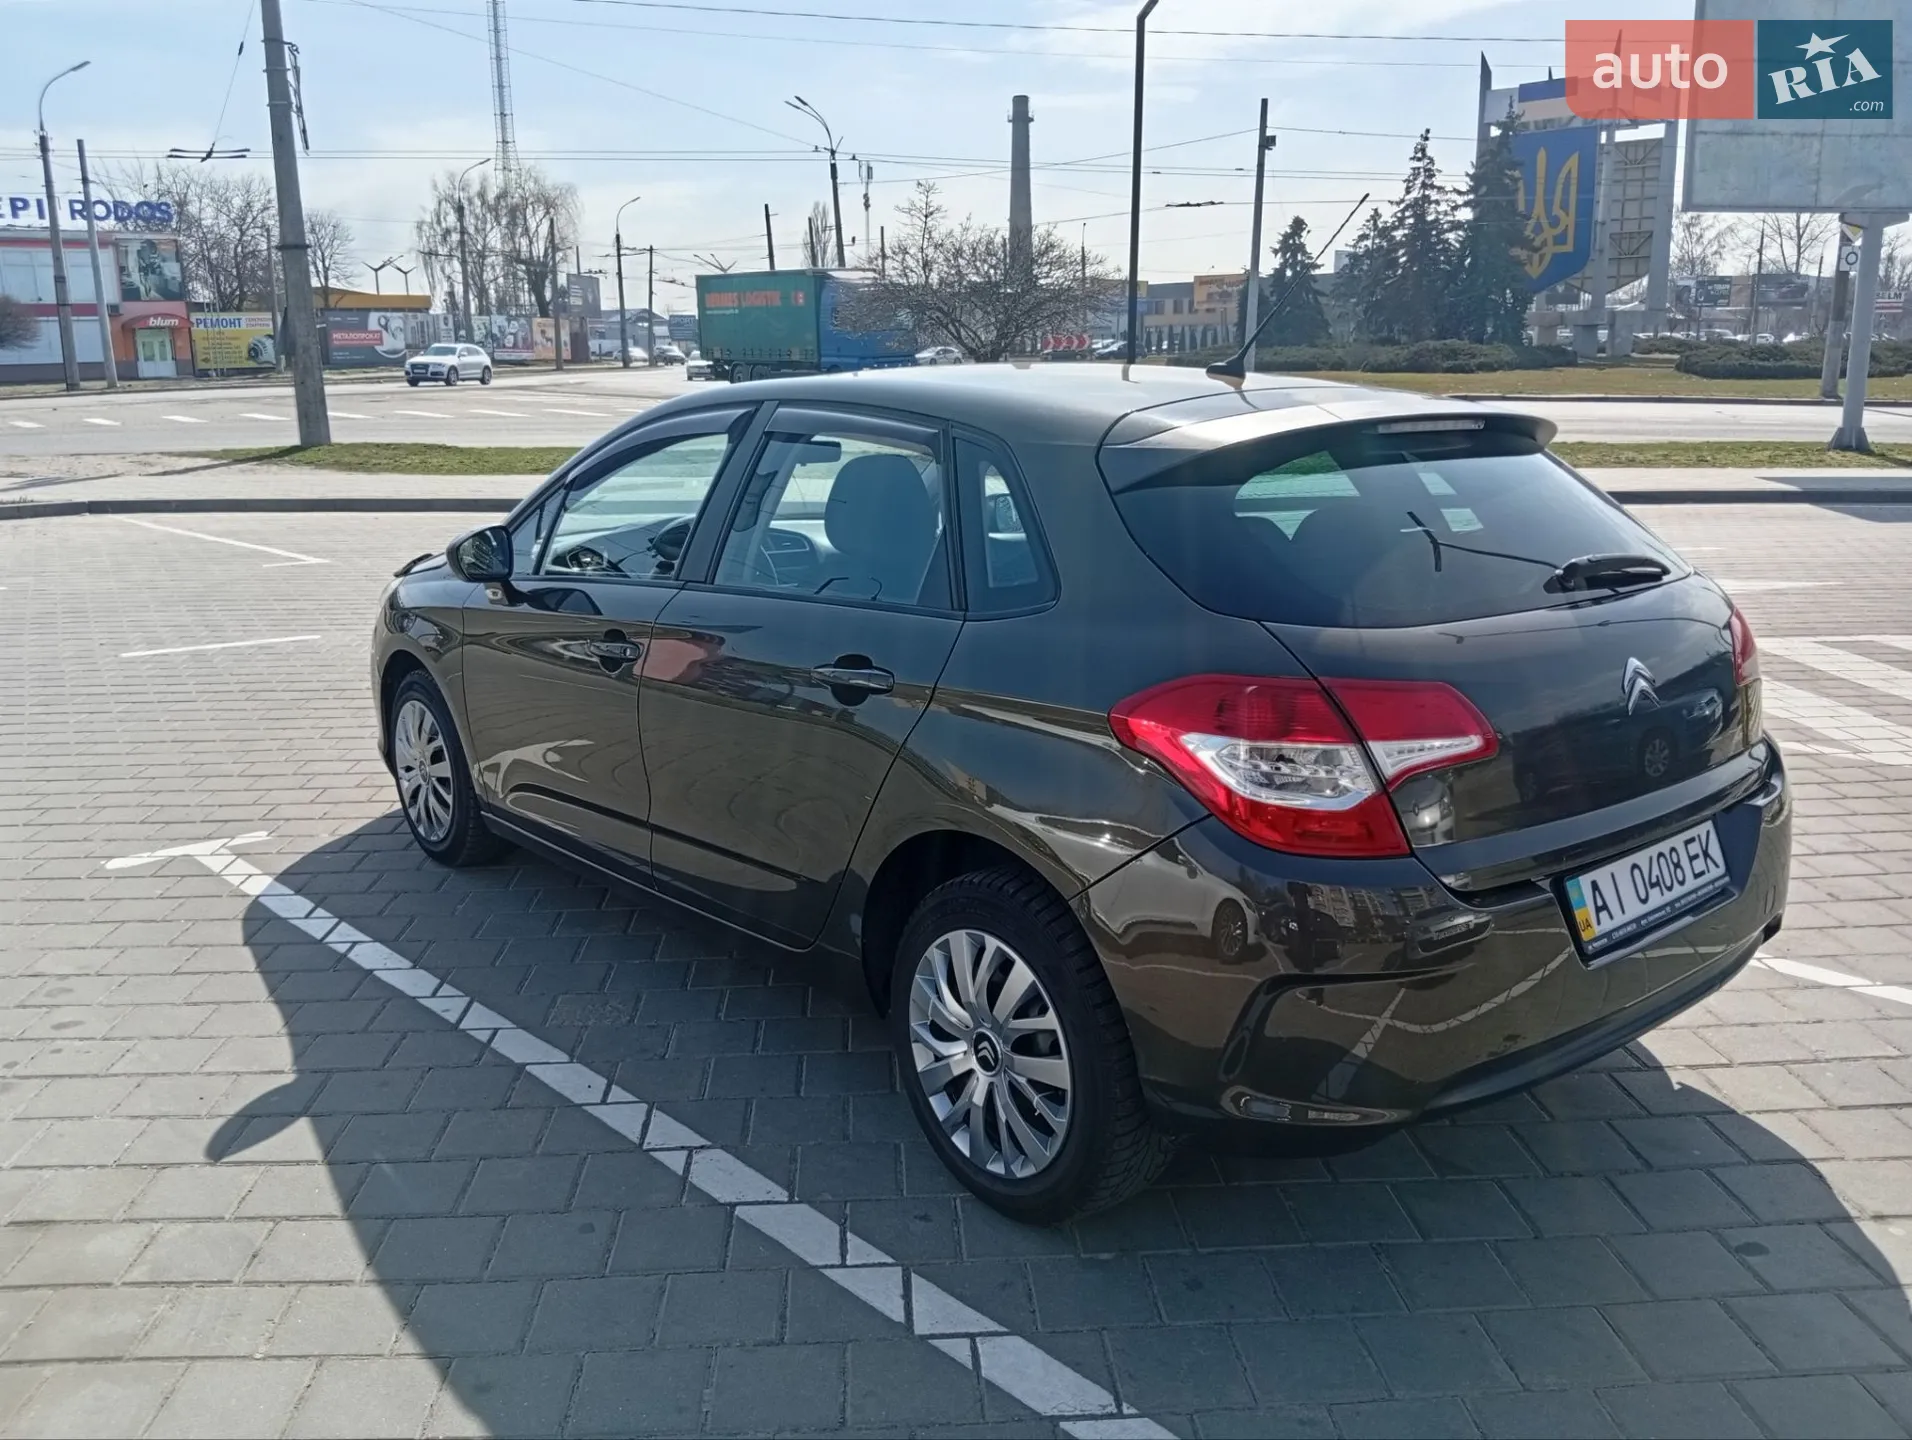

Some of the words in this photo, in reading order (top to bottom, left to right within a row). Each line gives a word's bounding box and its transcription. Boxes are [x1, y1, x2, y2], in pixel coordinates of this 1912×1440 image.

[68, 199, 174, 223] RODOS
[148, 317, 179, 326] blum
[195, 318, 242, 328] РЕМОНТ
[1590, 872, 1625, 926] AI
[1630, 846, 1686, 905] 0408
[1683, 829, 1720, 880] EK
[1579, 918, 1592, 932] UA
